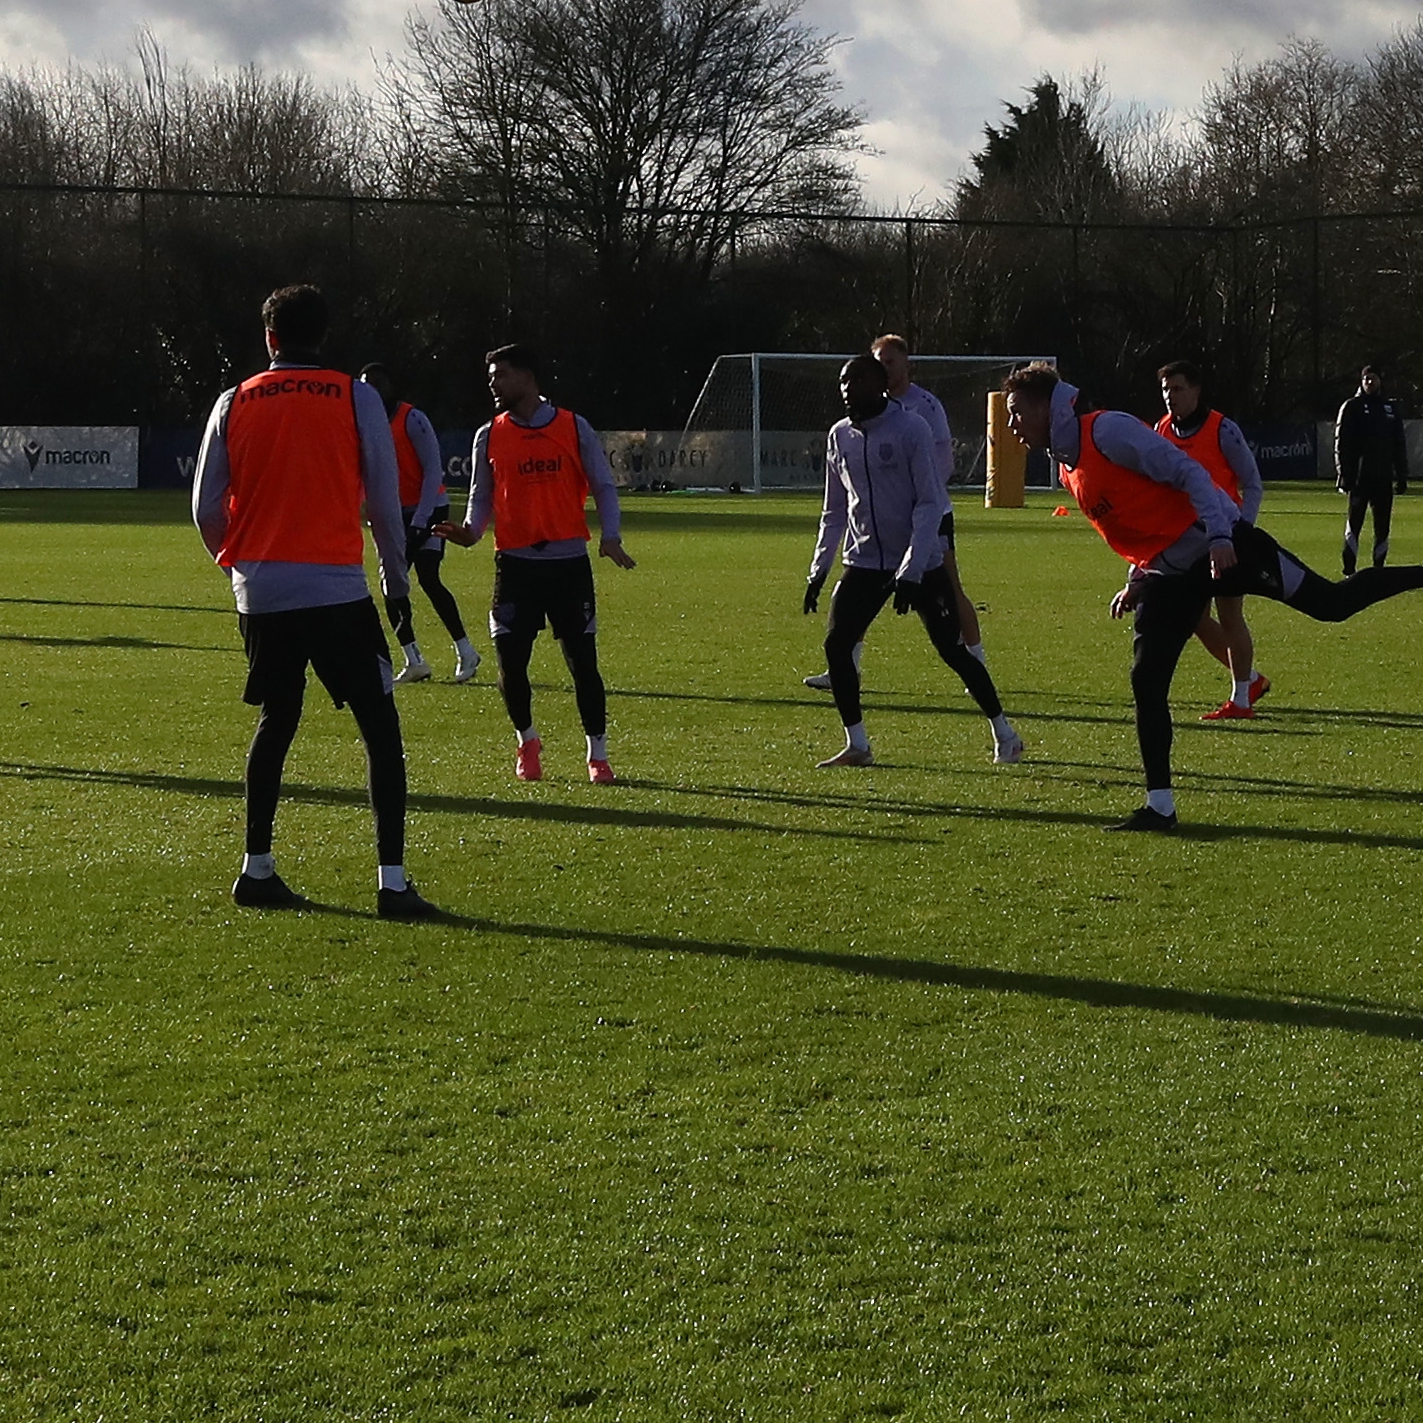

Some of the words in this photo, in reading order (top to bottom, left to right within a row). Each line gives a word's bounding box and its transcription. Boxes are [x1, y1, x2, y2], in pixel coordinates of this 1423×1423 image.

[239, 378, 342, 405] macron
[45, 449, 110, 465] macron
[658, 449, 707, 468] DARCY
[1260, 441, 1310, 459] macron
[517, 454, 562, 476] ideal
